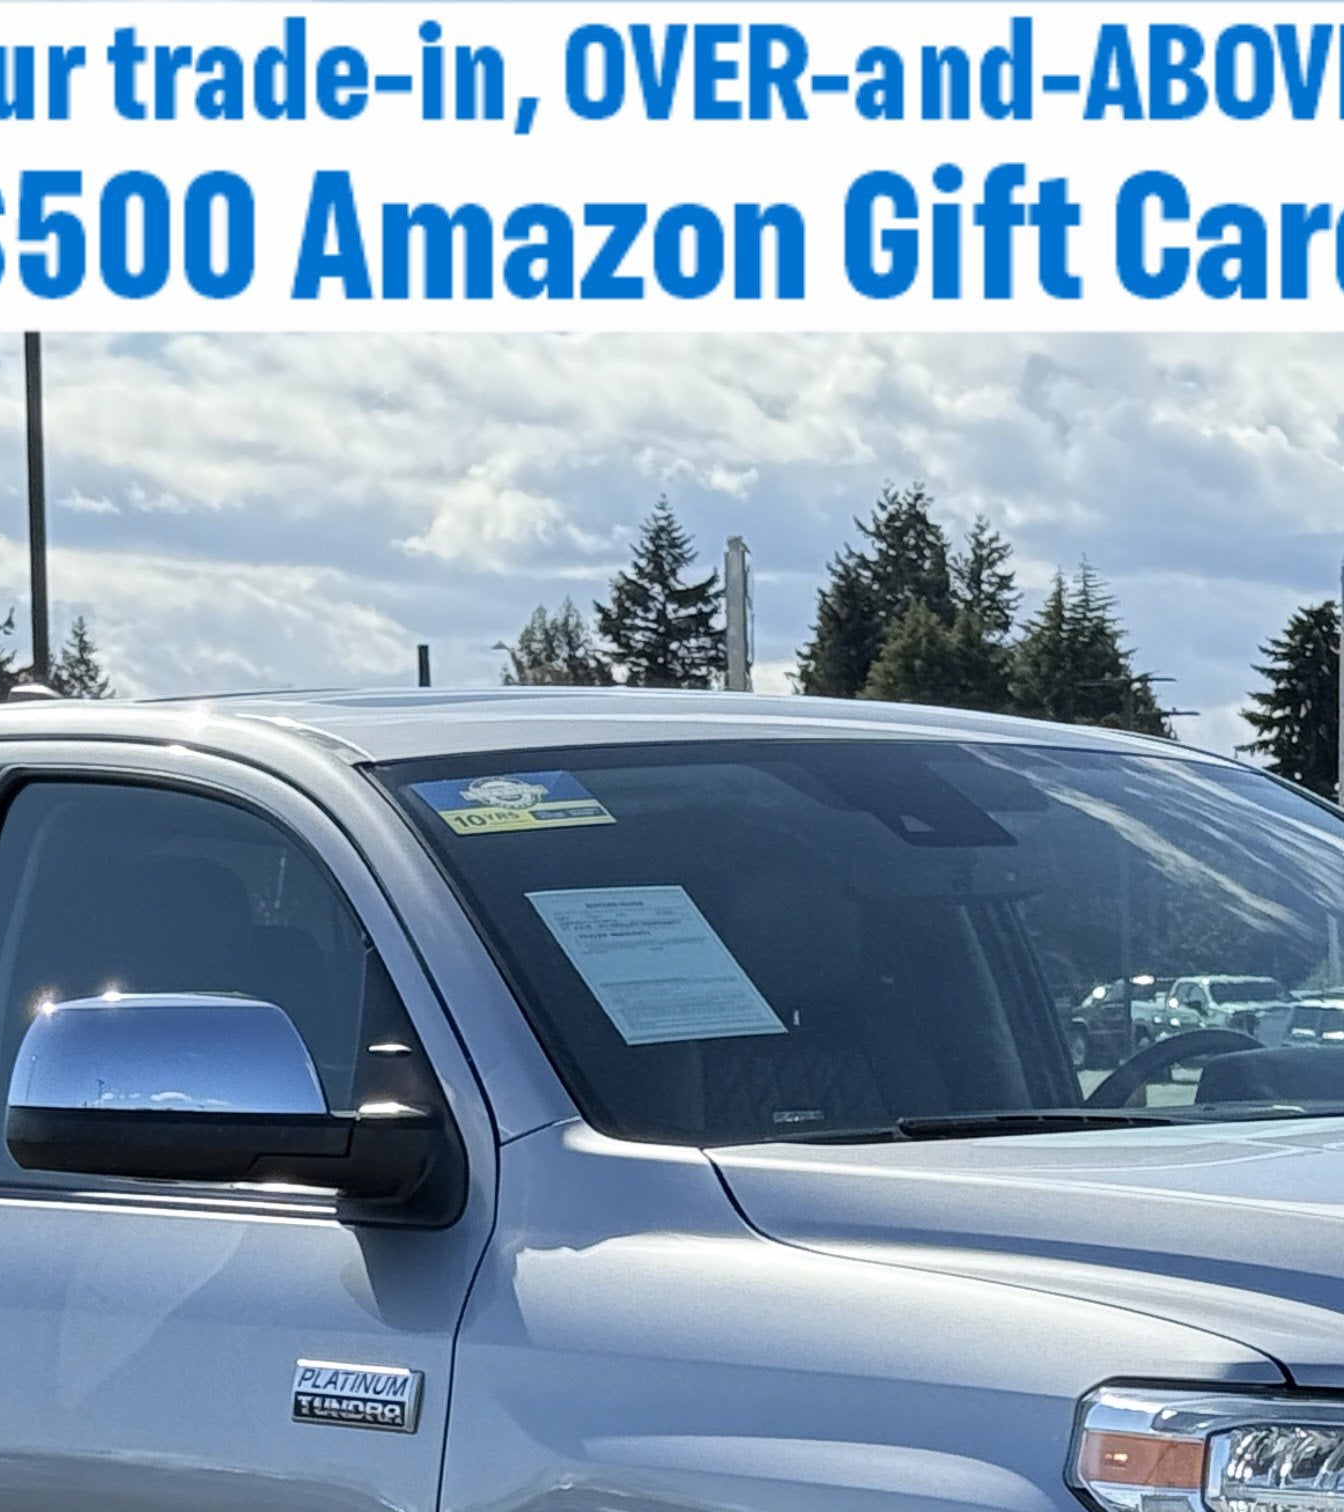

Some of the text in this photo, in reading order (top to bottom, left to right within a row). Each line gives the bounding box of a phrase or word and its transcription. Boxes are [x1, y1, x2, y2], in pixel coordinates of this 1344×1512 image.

[455, 814, 487, 828] 10
[297, 1368, 409, 1397] PLATINUM
[296, 1394, 403, 1425] TUNDRA
